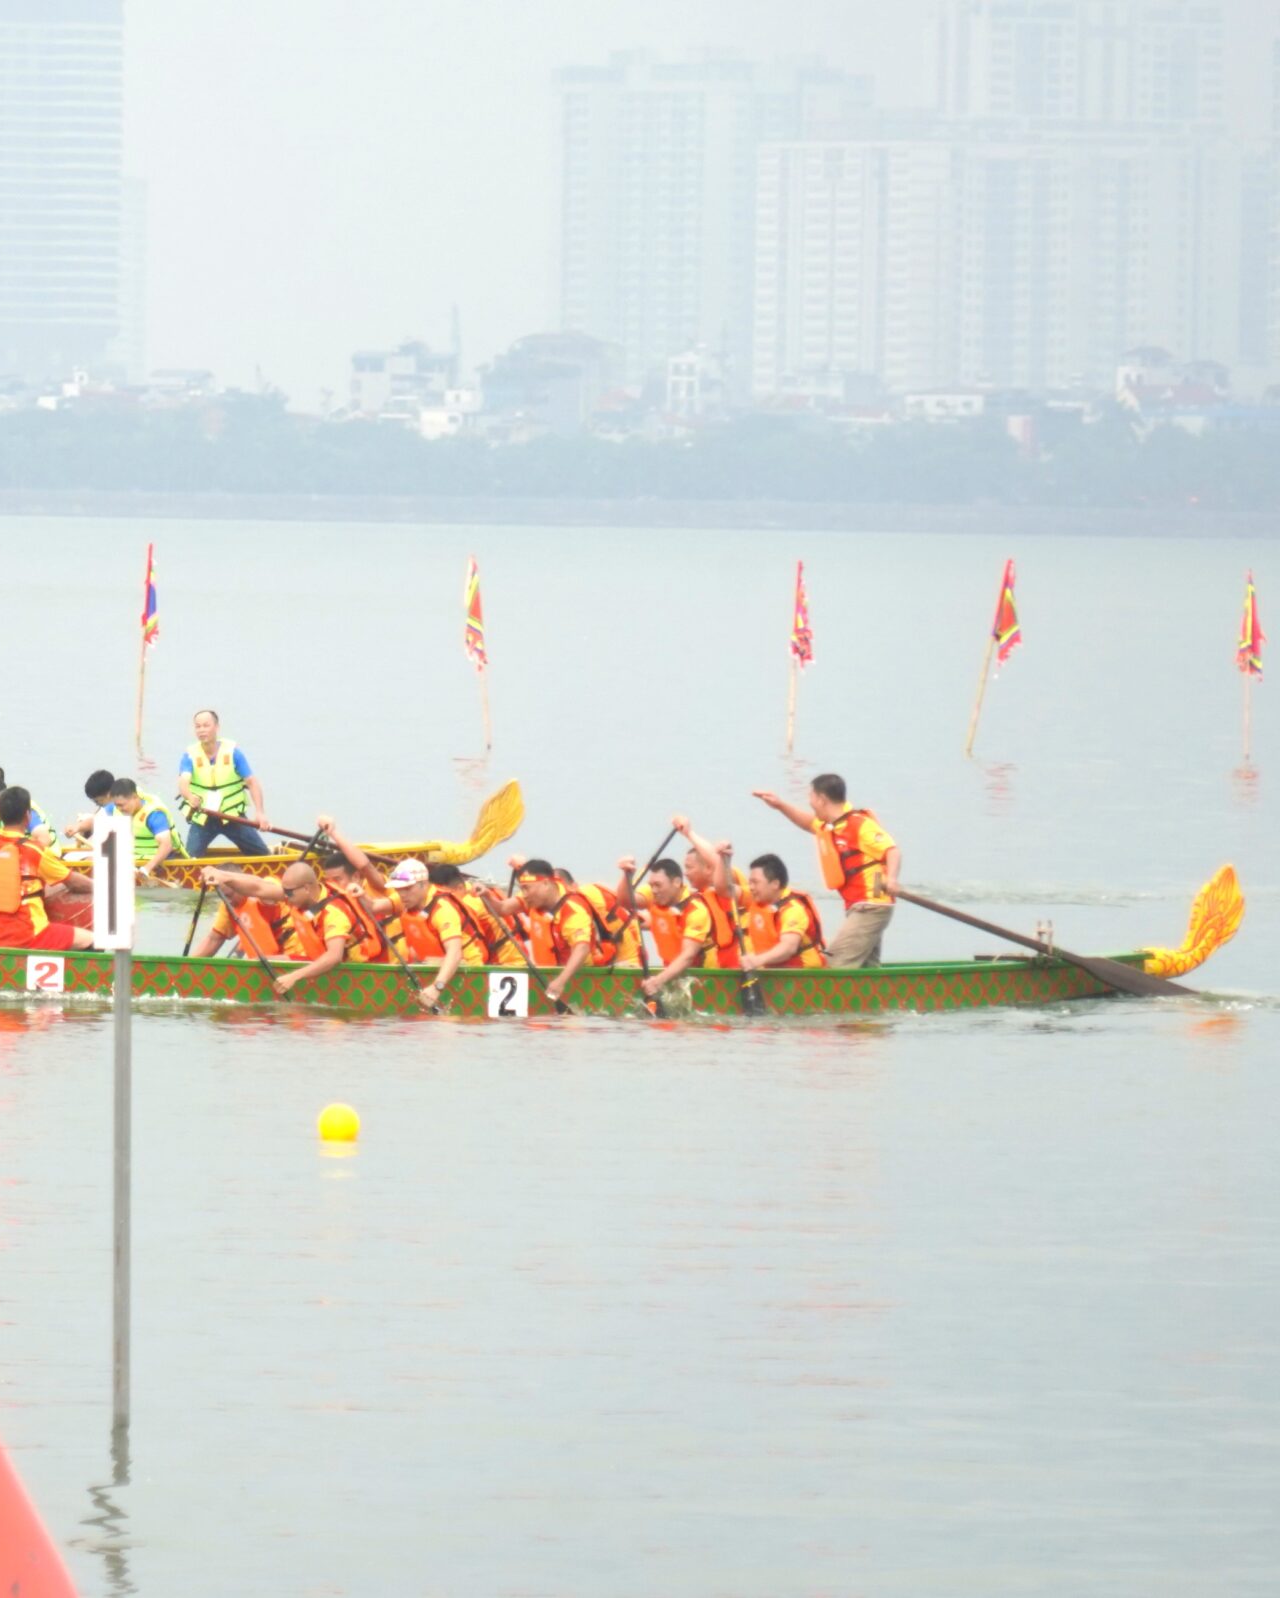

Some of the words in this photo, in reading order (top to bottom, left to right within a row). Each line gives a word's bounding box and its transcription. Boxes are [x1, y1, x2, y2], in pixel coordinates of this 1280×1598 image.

[101, 830, 117, 935] 1
[35, 962, 59, 987] 2
[498, 976, 517, 1016] 2
